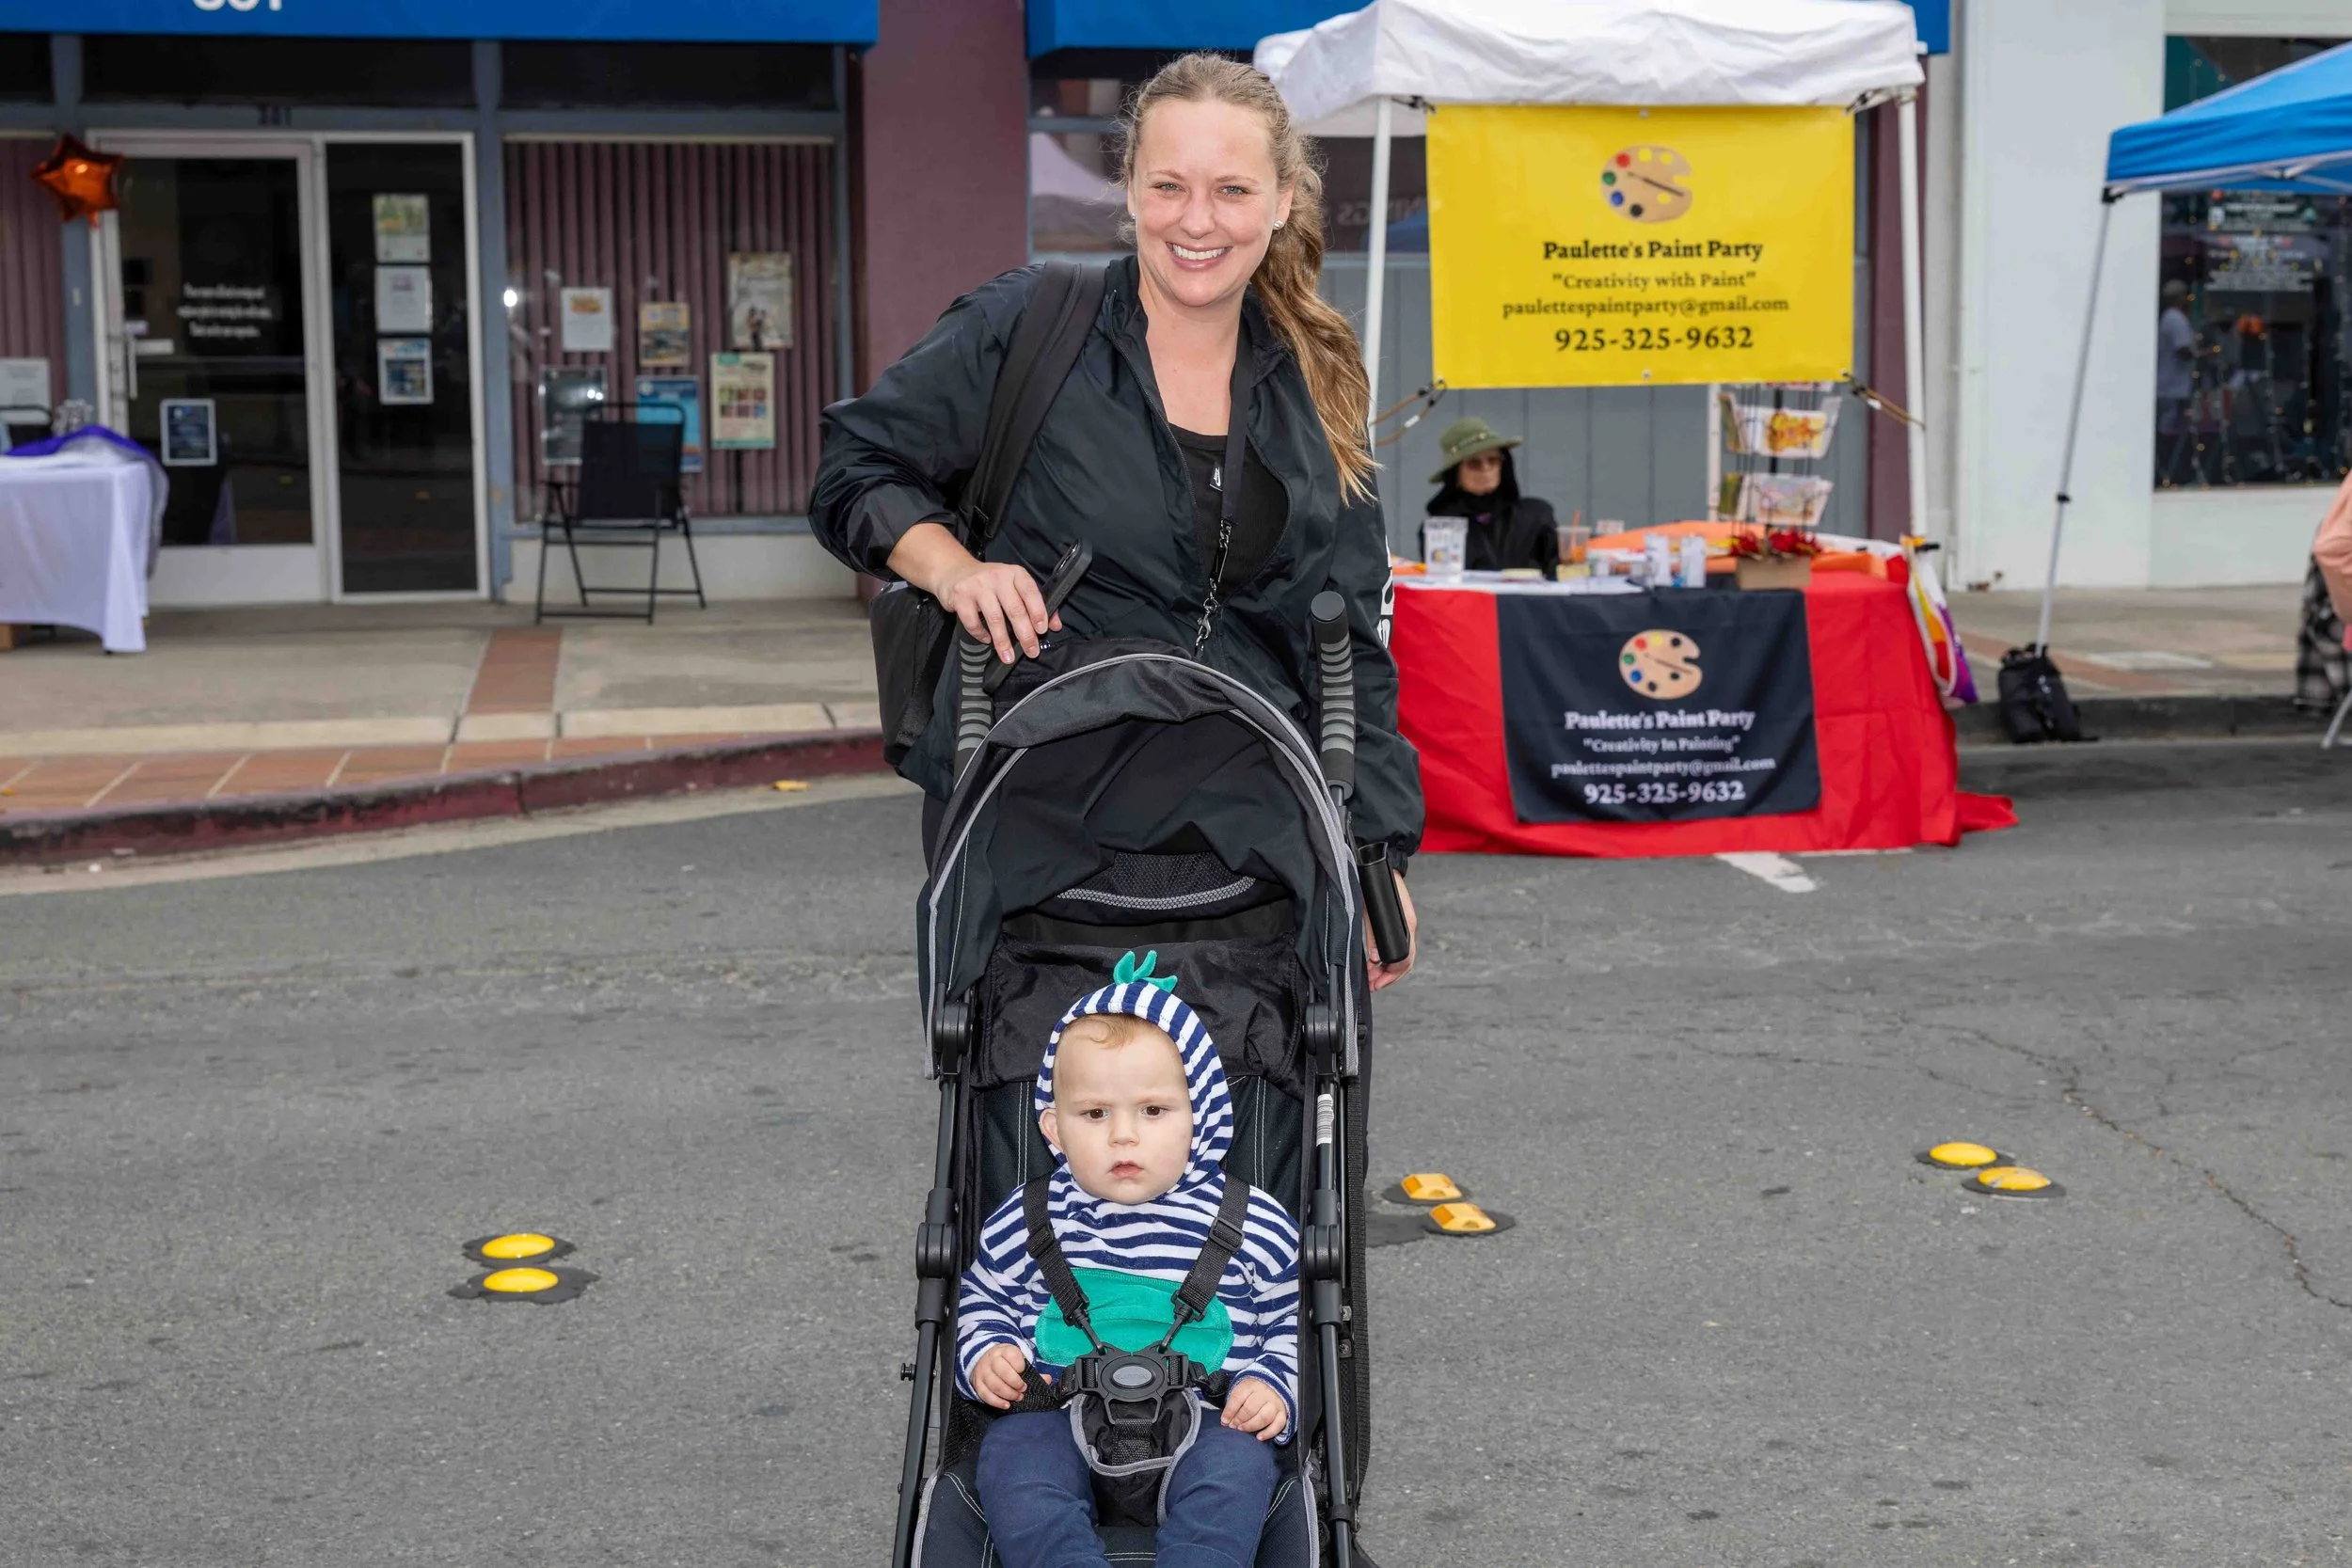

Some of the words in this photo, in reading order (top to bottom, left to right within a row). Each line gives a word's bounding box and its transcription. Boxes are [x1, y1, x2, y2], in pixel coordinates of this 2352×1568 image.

[1543, 239, 1644, 260] Paulette's
[1647, 239, 1702, 259] Paint
[1708, 240, 1764, 262] Party
[1552, 272, 1651, 291] "Creativity
[1655, 272, 1696, 288] with
[1700, 271, 1757, 288] Paint"
[1502, 294, 1789, 319] paulettespaintparty@gmail.com
[1555, 326, 1755, 352] 925-325-9632
[1565, 710, 1654, 729] Paulette's
[1655, 709, 1706, 729] Paint
[1707, 708, 1756, 732] Party
[1661, 737, 1677, 752] In
[1678, 736, 1740, 752] Painting"
[1551, 756, 1776, 779] paulettespaintparty@gmail.com
[1583, 780, 1746, 805] 925-325-9632
